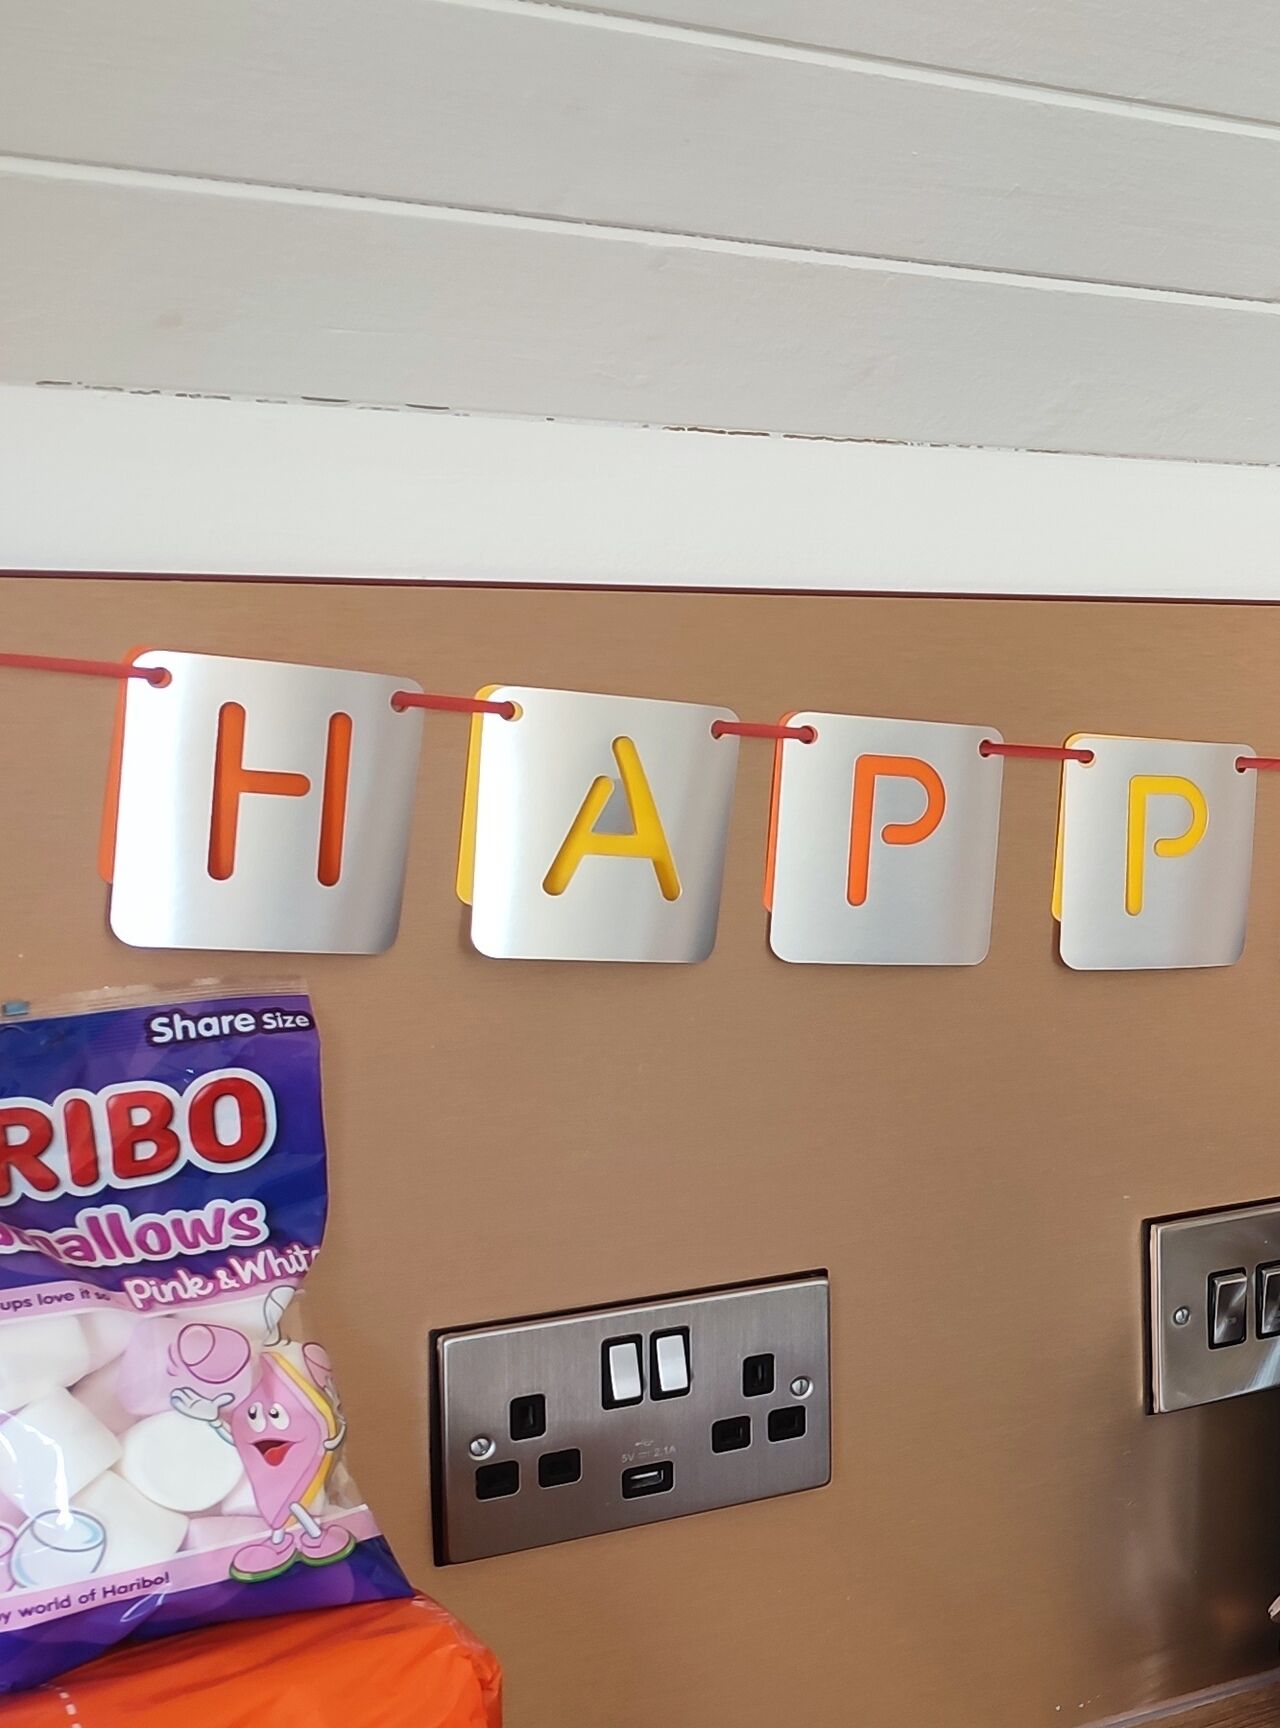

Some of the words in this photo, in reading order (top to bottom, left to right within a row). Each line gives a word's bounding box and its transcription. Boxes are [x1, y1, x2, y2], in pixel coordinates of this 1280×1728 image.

[150, 1012, 256, 1044] Share
[262, 1012, 310, 1029] Size
[37, 1293, 75, 1305] love
[124, 1269, 214, 1309] Pink
[217, 1270, 239, 1290] &
[18, 1595, 71, 1618] world
[78, 1590, 96, 1604] of
[102, 1572, 169, 1599] Haribo!
